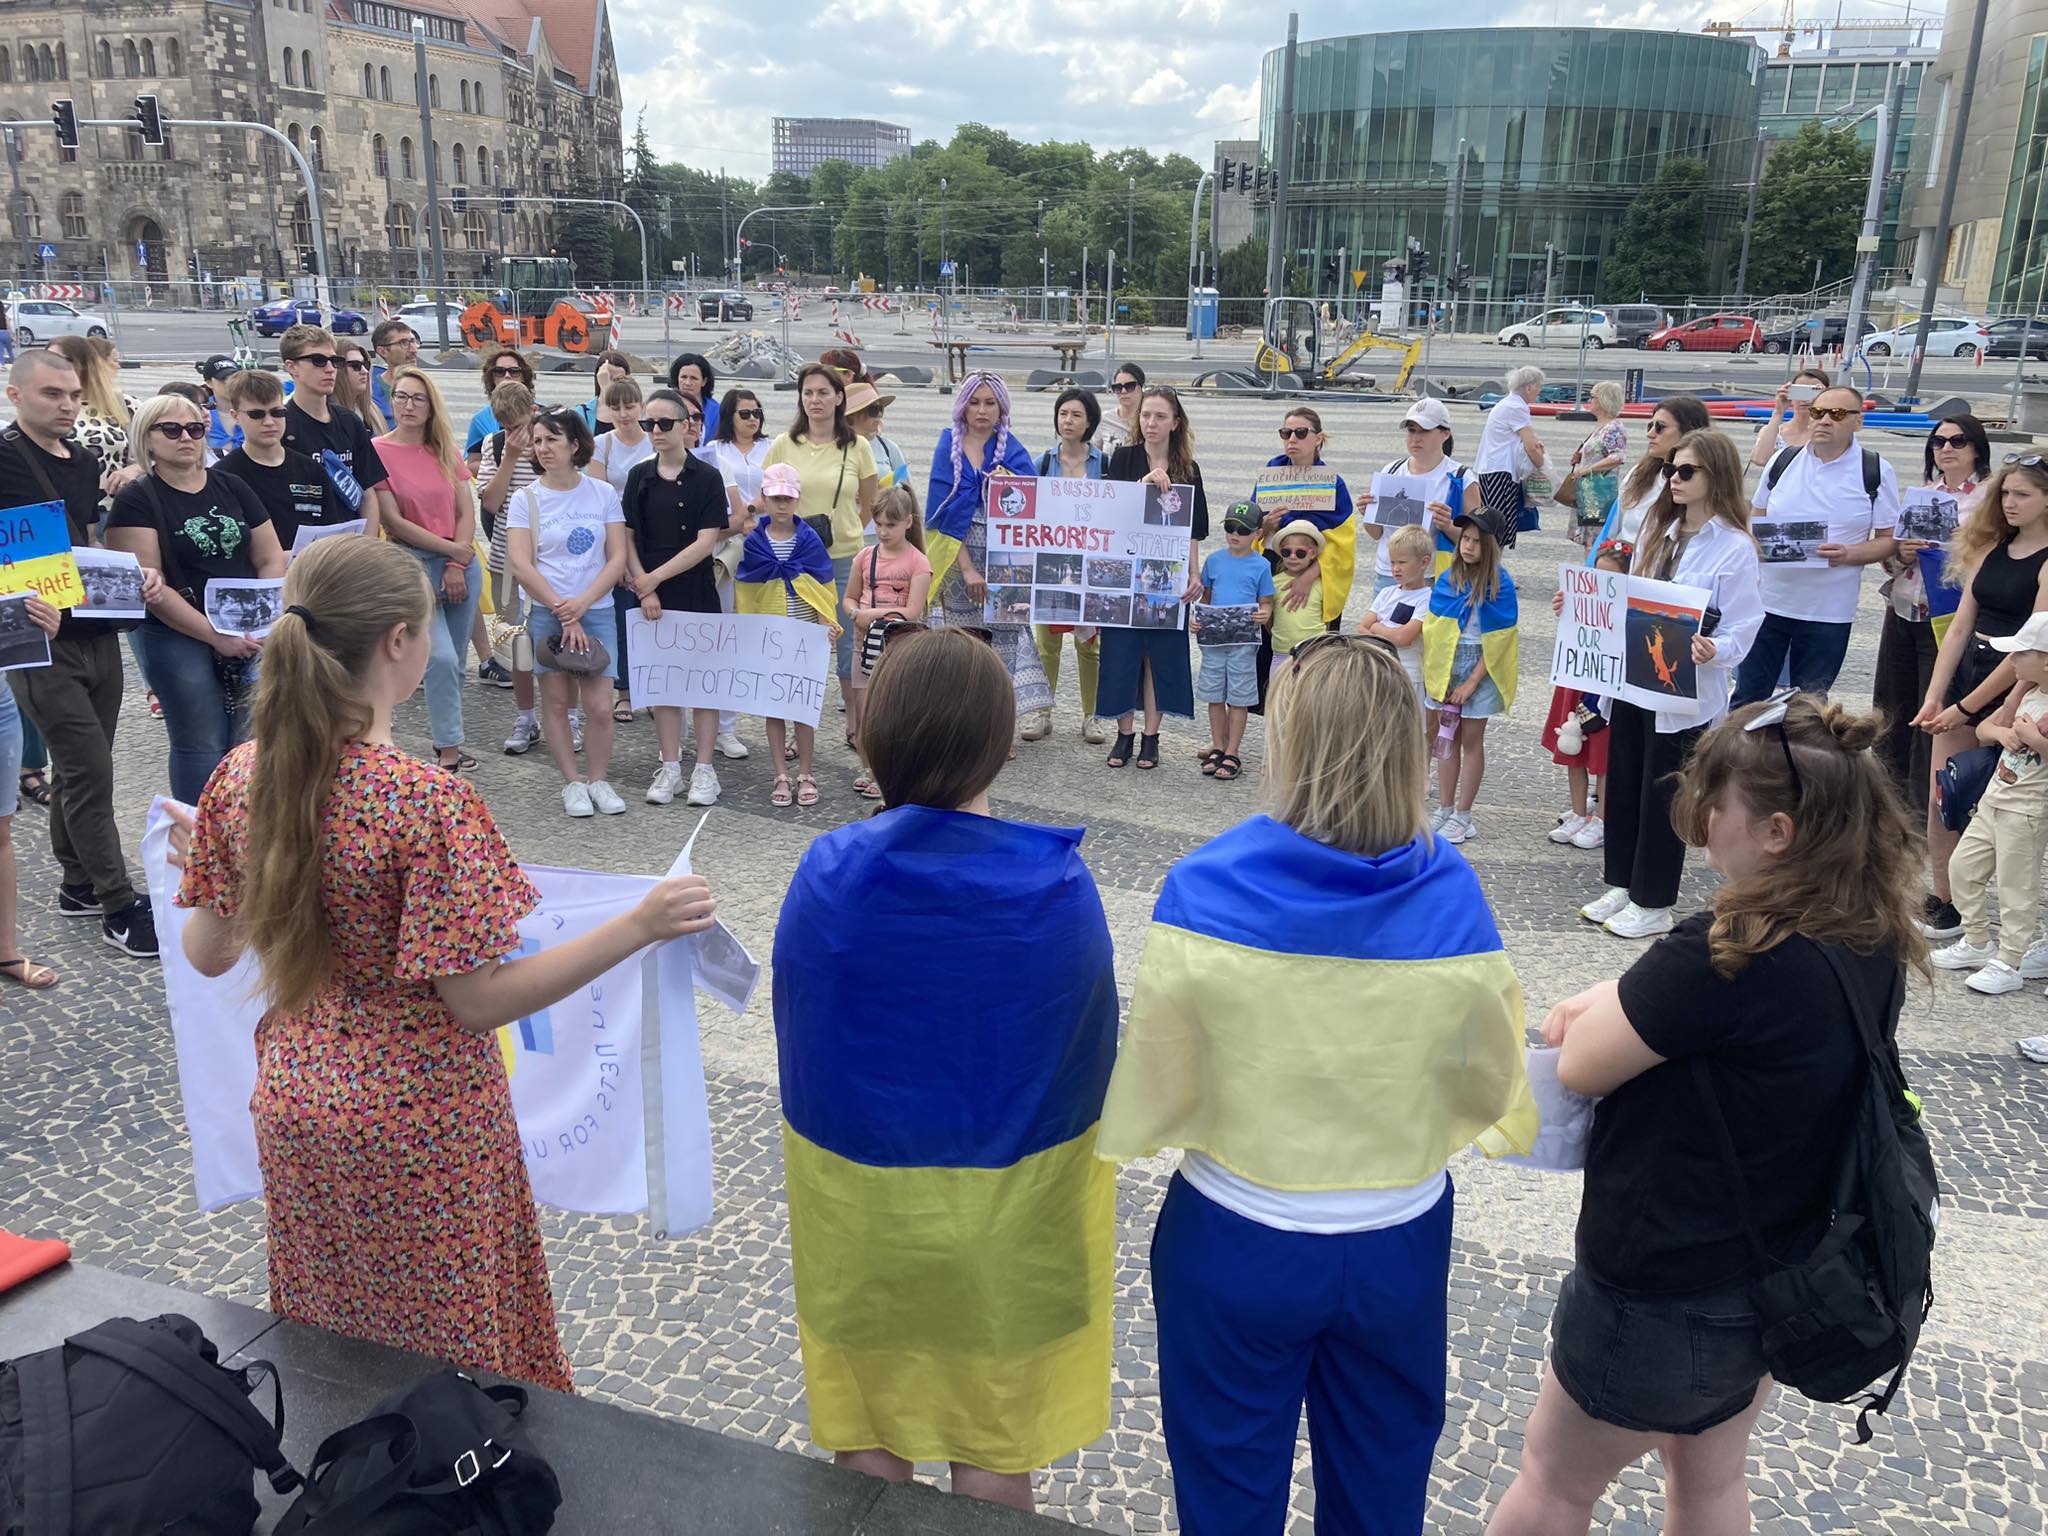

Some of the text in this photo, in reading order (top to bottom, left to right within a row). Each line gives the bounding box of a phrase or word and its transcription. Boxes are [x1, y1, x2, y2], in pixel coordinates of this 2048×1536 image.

[1051, 480, 1116, 499] RUSSIA
[1074, 504, 1092, 521] IS
[996, 524, 1190, 560] TERRORIST STATE
[3, 553, 15, 571] A
[1573, 596, 1614, 631] KILLING
[794, 638, 809, 665] A
[1577, 626, 1602, 652] OUR
[770, 672, 828, 711] STATE
